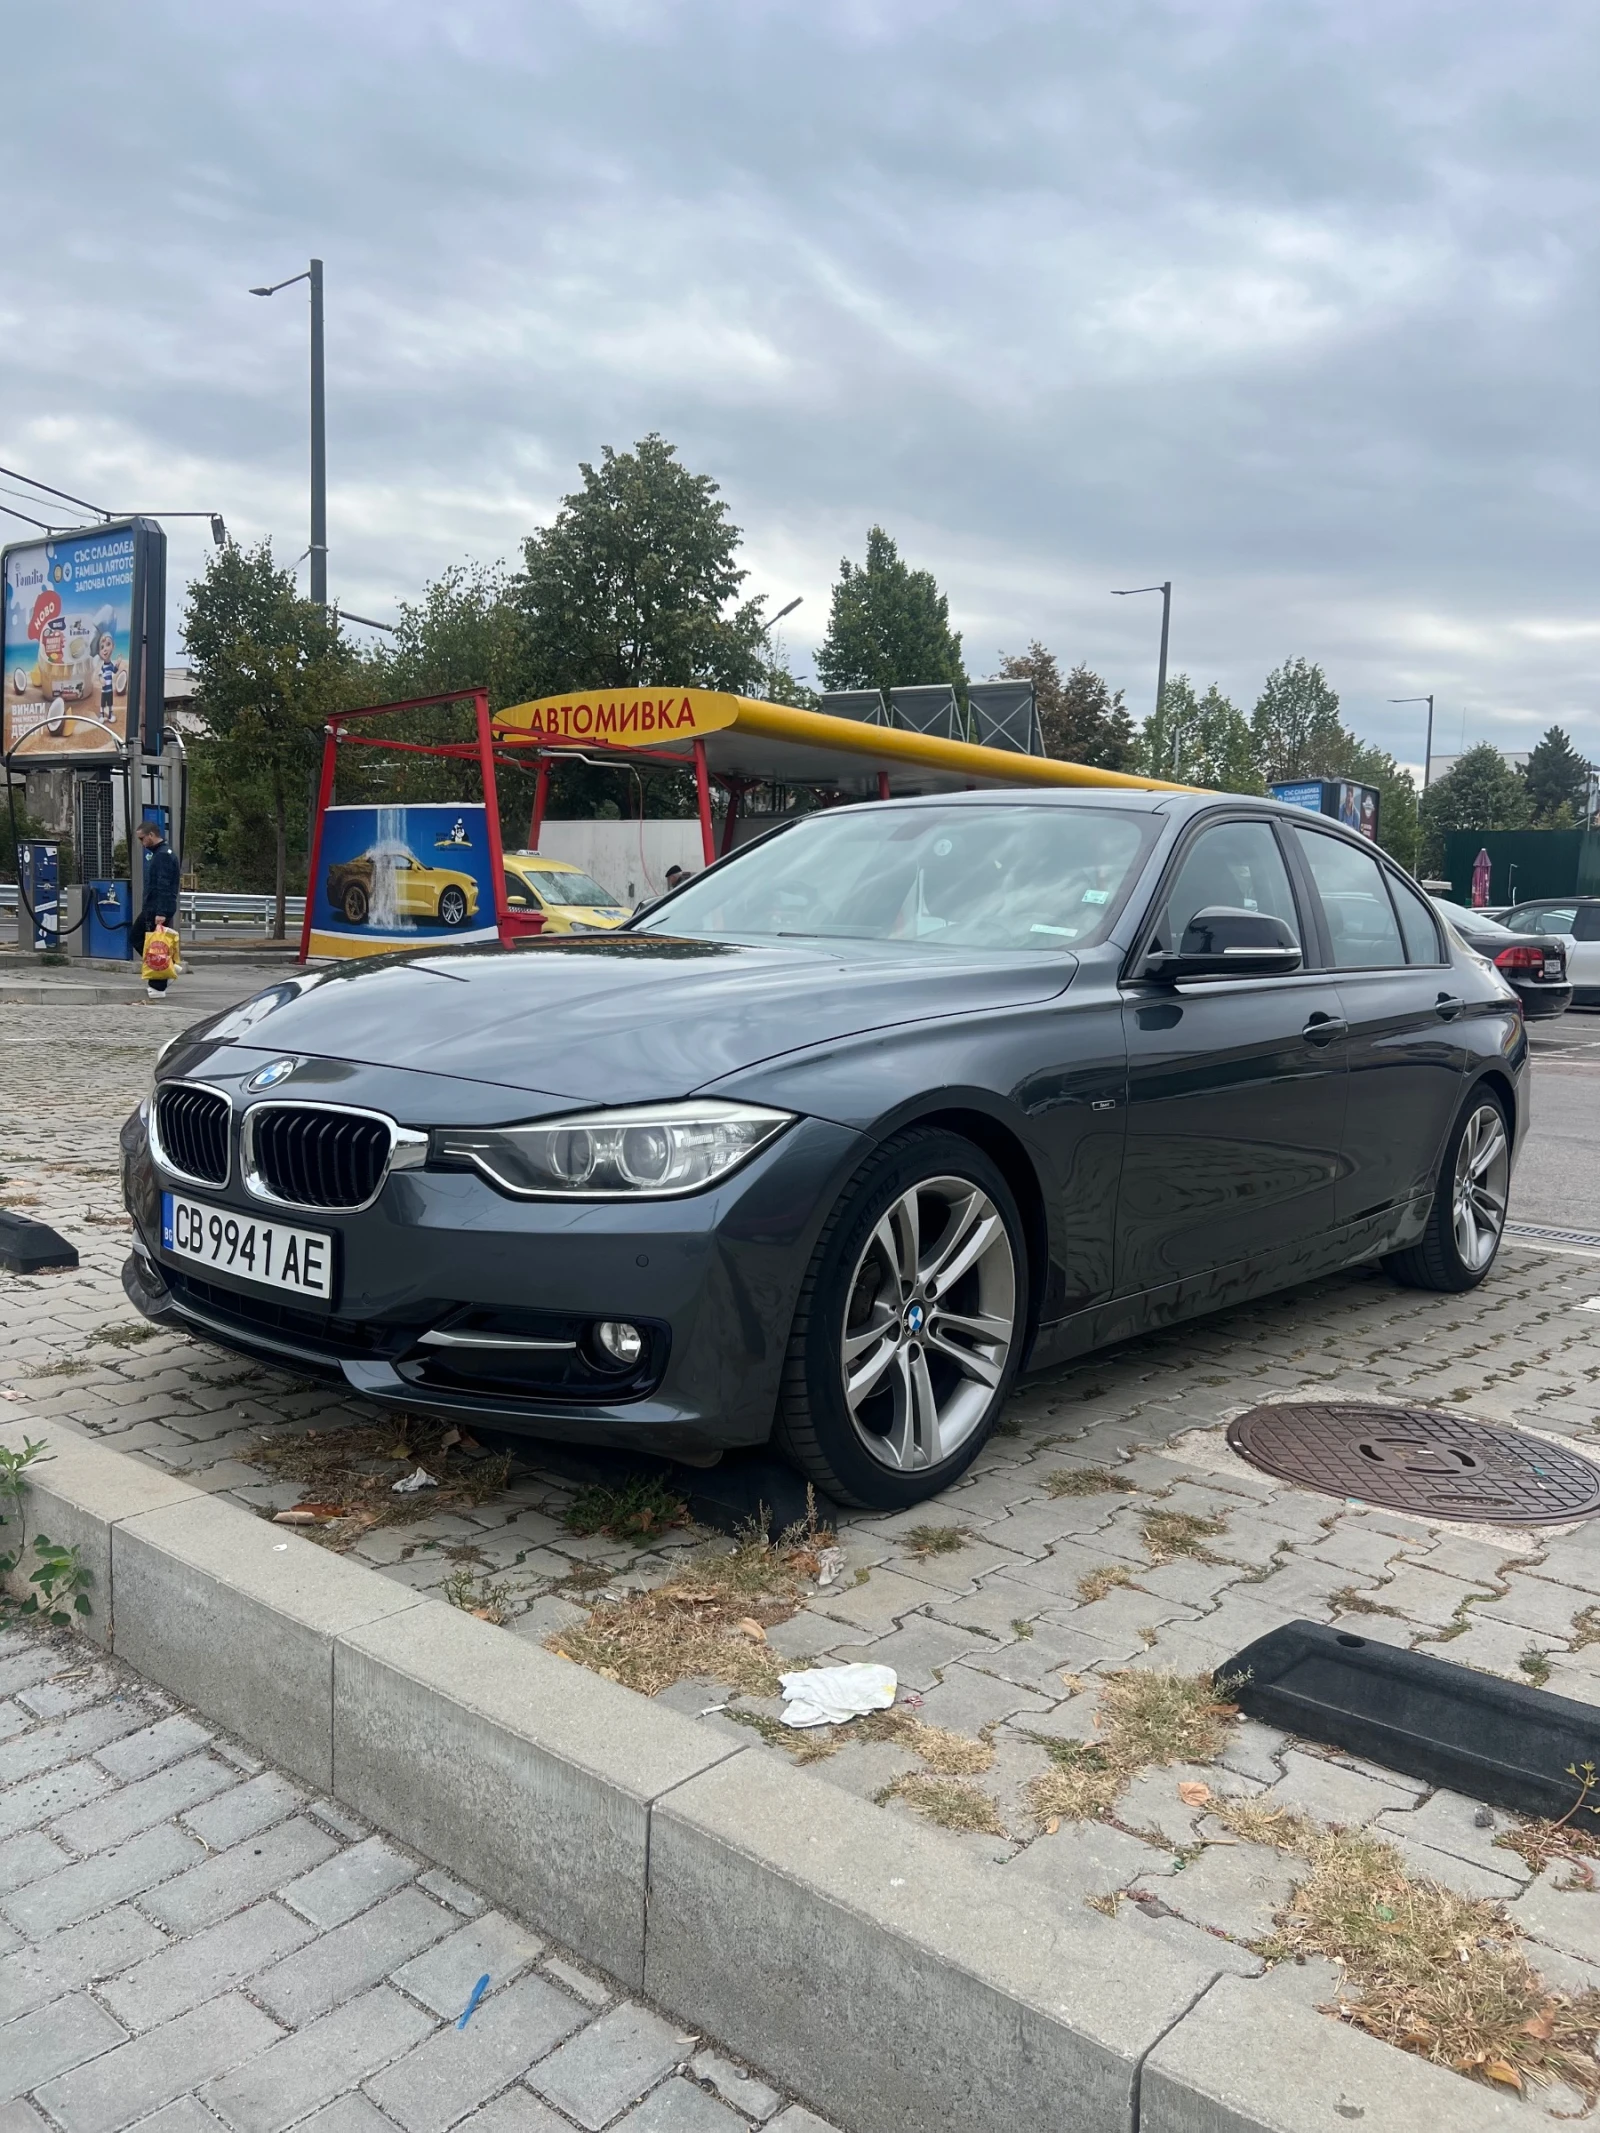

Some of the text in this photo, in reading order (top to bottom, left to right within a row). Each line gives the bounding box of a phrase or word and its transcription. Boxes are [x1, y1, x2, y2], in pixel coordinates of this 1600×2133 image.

[74, 540, 135, 563] СЪС СЛАДОЛЕД
[75, 562, 104, 578] FAMILIA
[75, 577, 105, 592] ЗАПОЧВА
[34, 601, 55, 630] НОВО
[11, 702, 46, 716] ВИНАГИ
[530, 697, 696, 735] АВТОМИВКА
[164, 1227, 173, 1241] BG
[176, 1203, 324, 1290] CB 9941 AE
